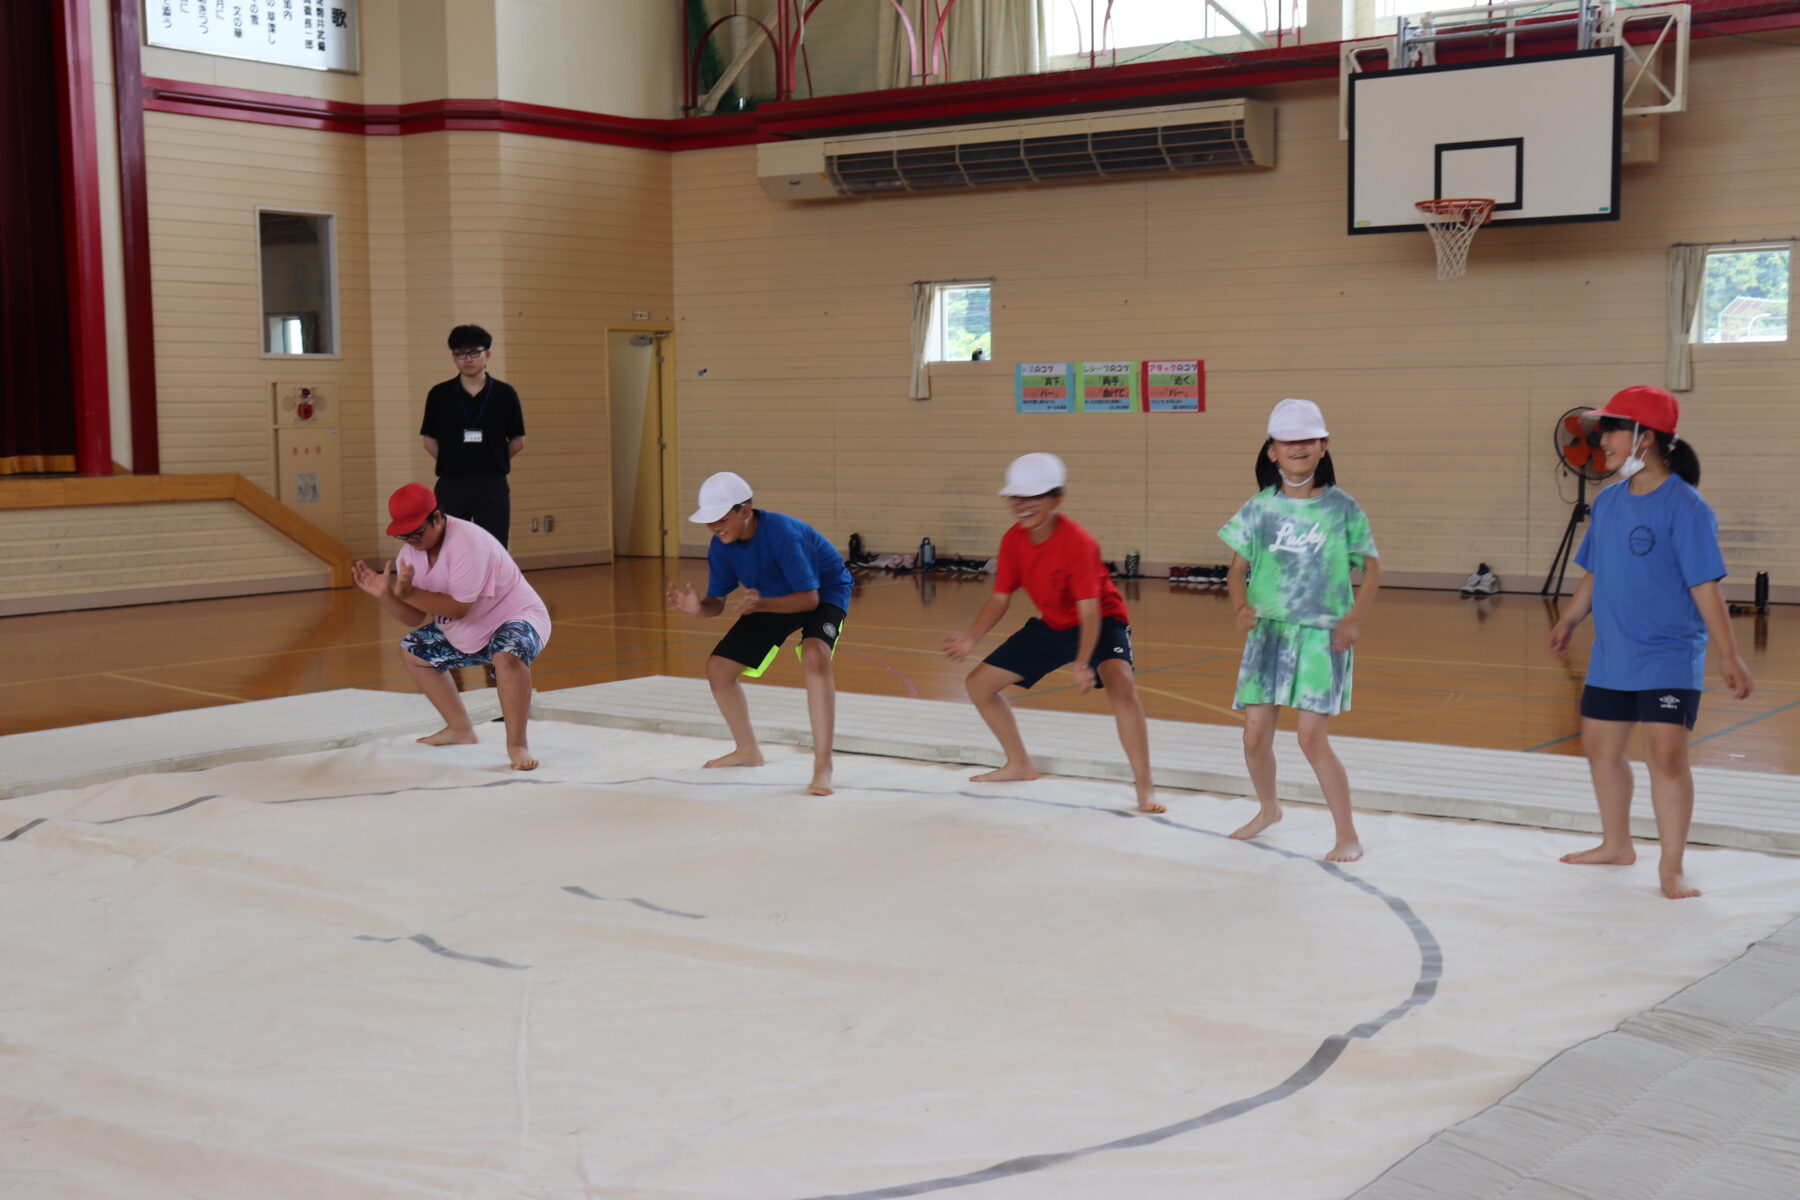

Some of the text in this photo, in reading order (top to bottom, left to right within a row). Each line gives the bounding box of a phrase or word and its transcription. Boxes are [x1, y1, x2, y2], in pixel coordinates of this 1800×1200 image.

[331, 7, 347, 28] 歌
[1083, 364, 1129, 373] レシーブのコツ
[1150, 363, 1197, 372] アタックのコツ
[1268, 522, 1328, 554] Lucky
